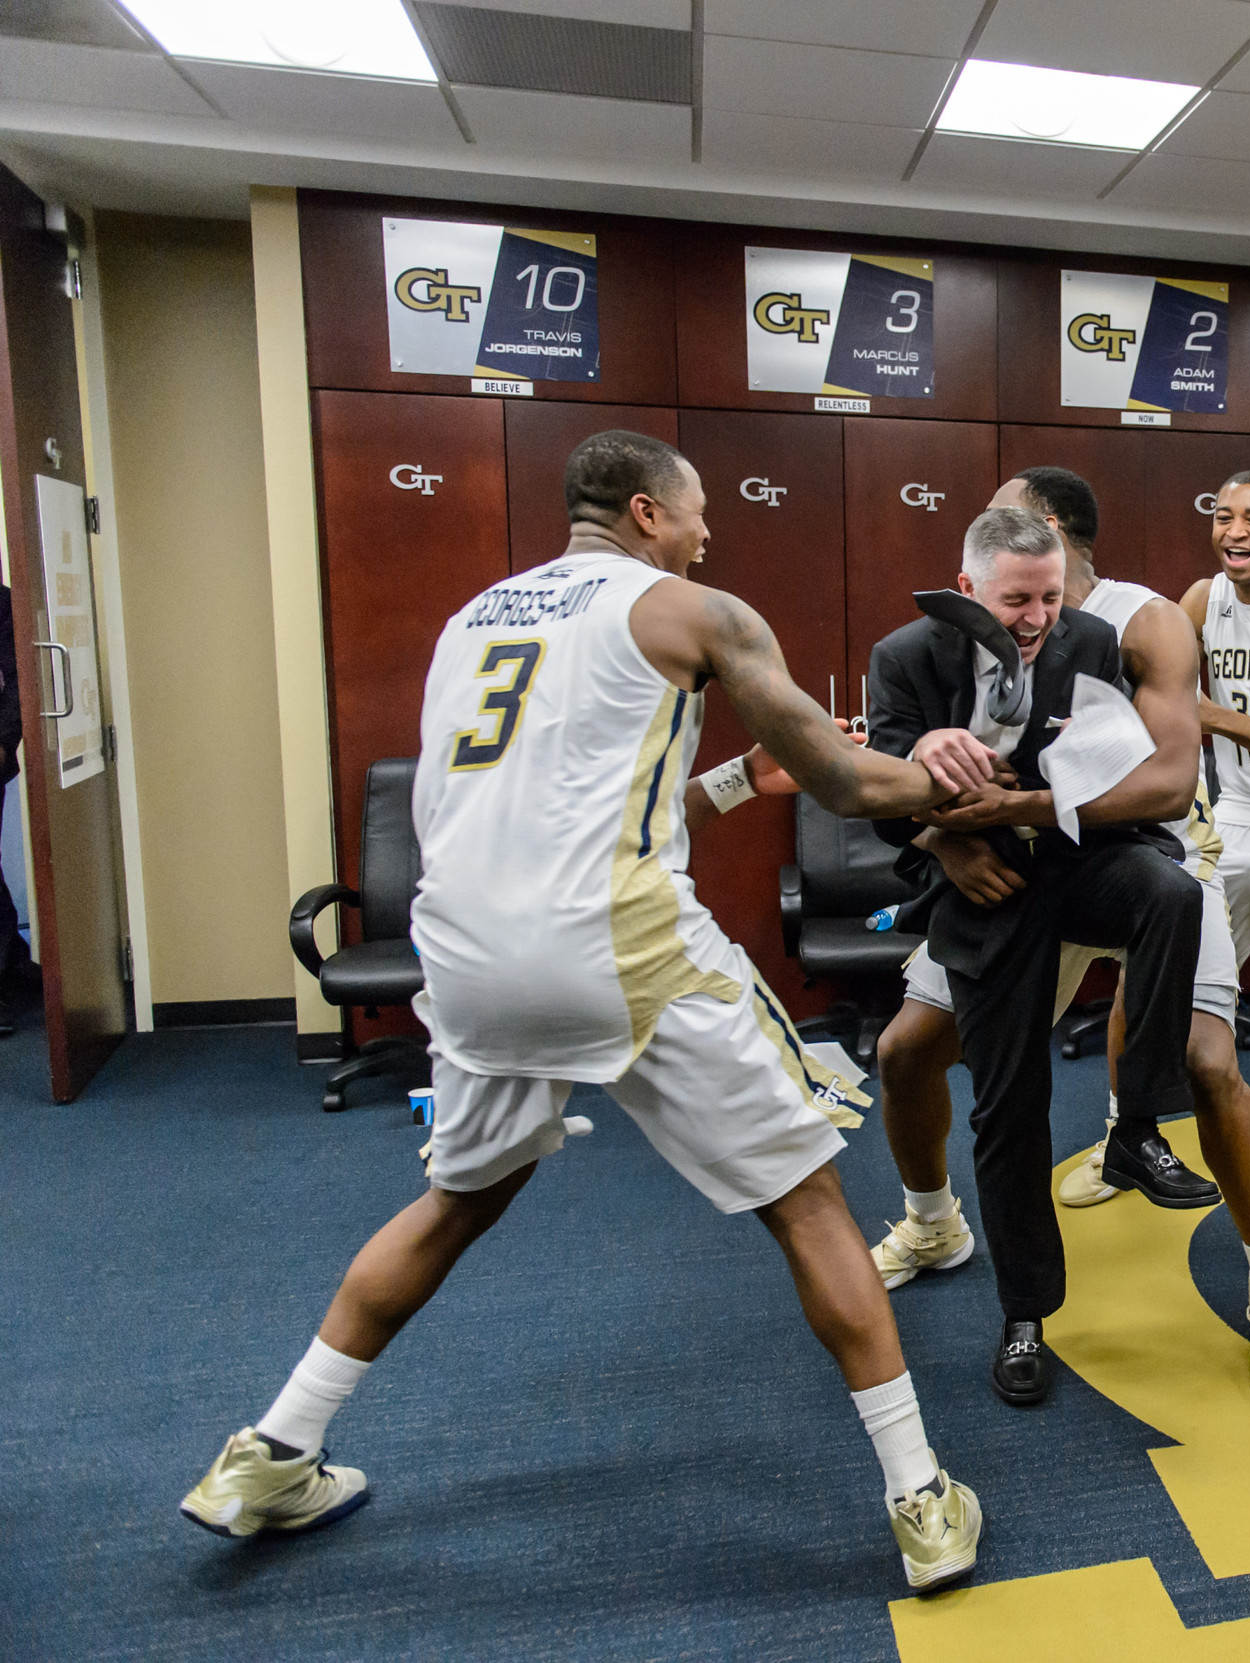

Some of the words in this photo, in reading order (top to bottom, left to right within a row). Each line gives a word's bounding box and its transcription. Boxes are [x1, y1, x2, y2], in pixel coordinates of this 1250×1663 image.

[394, 267, 482, 323] GT
[516, 264, 586, 312] 10
[753, 292, 830, 344] GT
[885, 290, 921, 333] 3
[523, 329, 582, 343] TRAVIS
[1067, 313, 1136, 362] GT
[1184, 311, 1218, 352] 2
[485, 342, 583, 358] JORGENSON
[853, 349, 919, 362] MARCUS
[876, 364, 920, 376] HUNT
[1173, 368, 1215, 379] ADAM
[484, 381, 521, 394] BELIEVE
[1170, 381, 1215, 392] SMITH
[817, 399, 867, 411] RELENTLESS
[1138, 414, 1154, 423] NOW
[389, 464, 443, 496] GT
[740, 477, 787, 507] GT
[900, 483, 945, 512] GT
[1194, 492, 1218, 515] G
[466, 578, 608, 629] GEORGES-HUNT
[447, 637, 547, 774] 3
